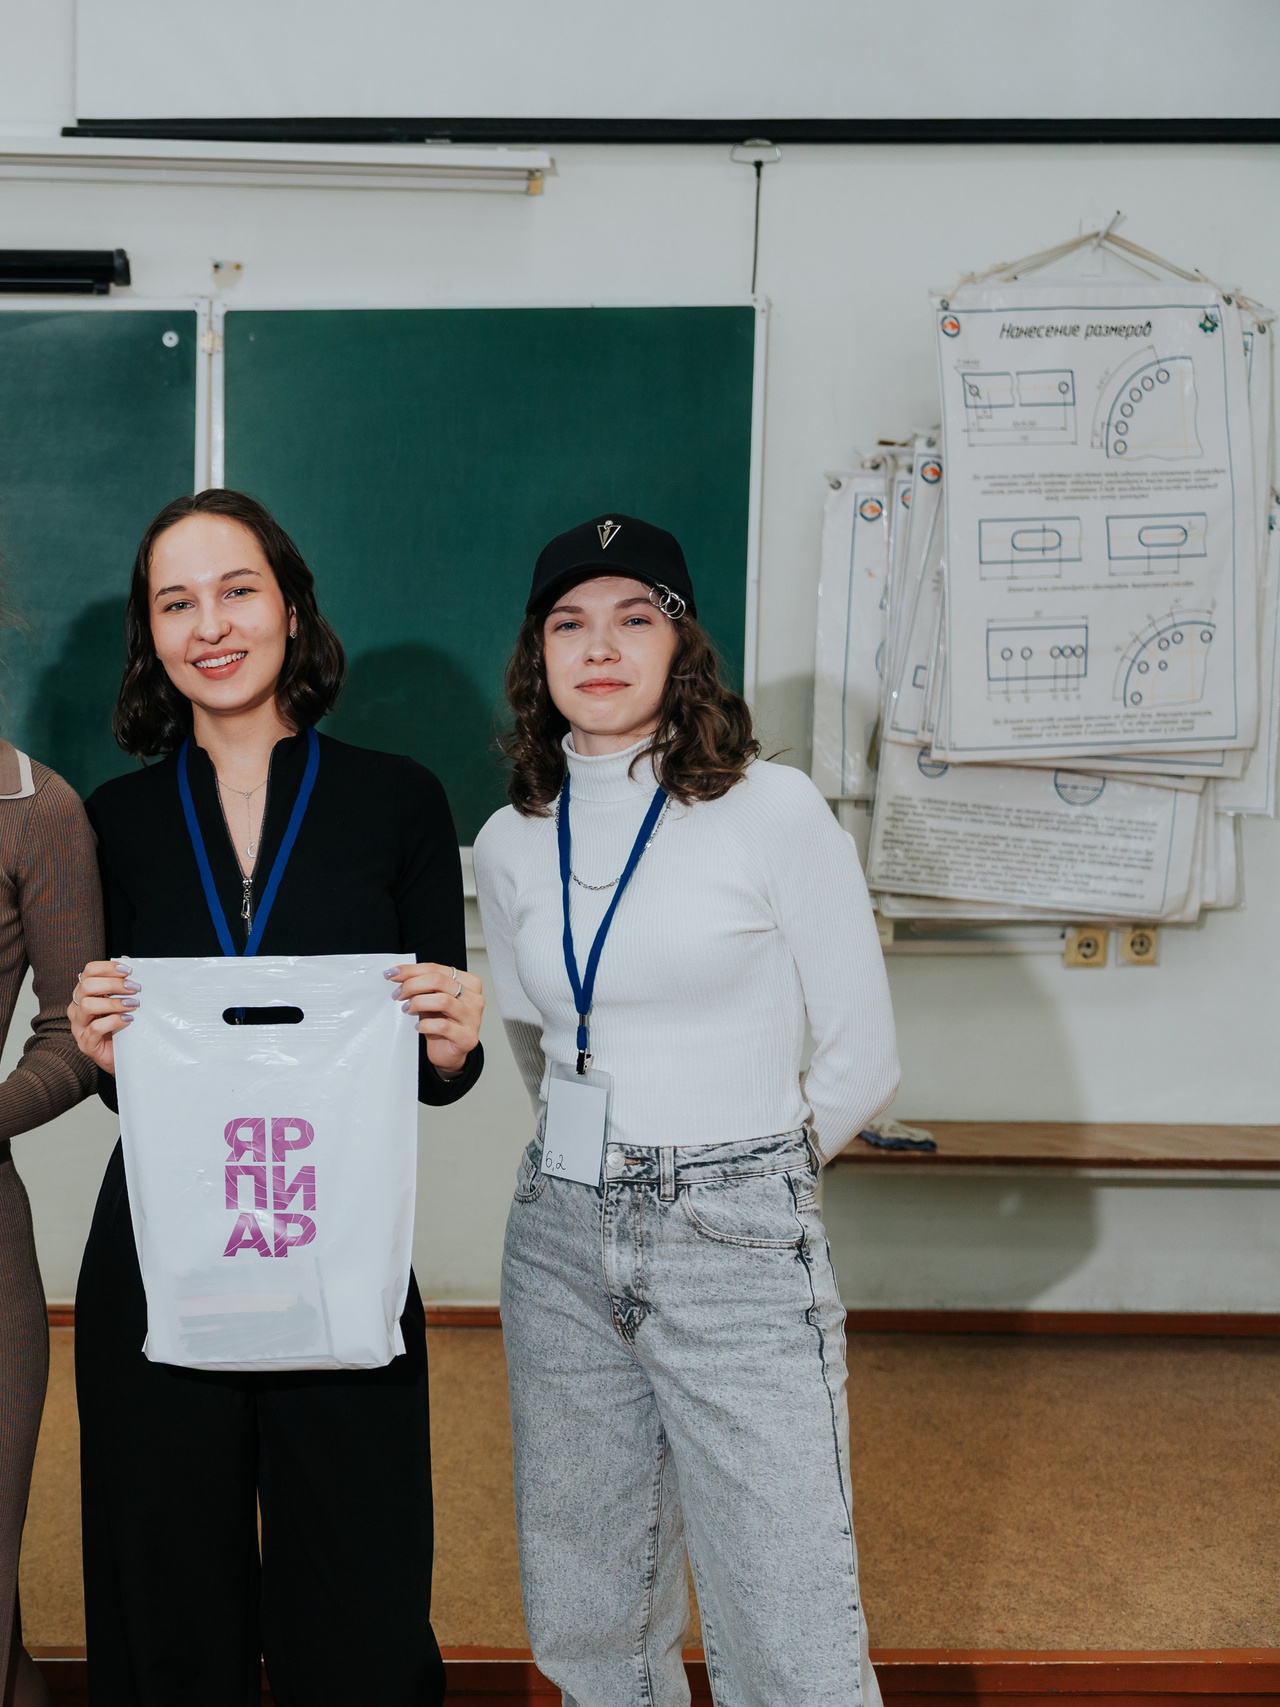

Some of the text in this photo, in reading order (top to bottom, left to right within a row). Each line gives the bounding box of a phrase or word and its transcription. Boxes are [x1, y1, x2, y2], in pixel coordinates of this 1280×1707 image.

[999, 320, 1153, 341] Нанесение размеров
[224, 1117, 315, 1162] ЯР
[225, 1165, 316, 1211] ПИ
[223, 1213, 317, 1258] АР
